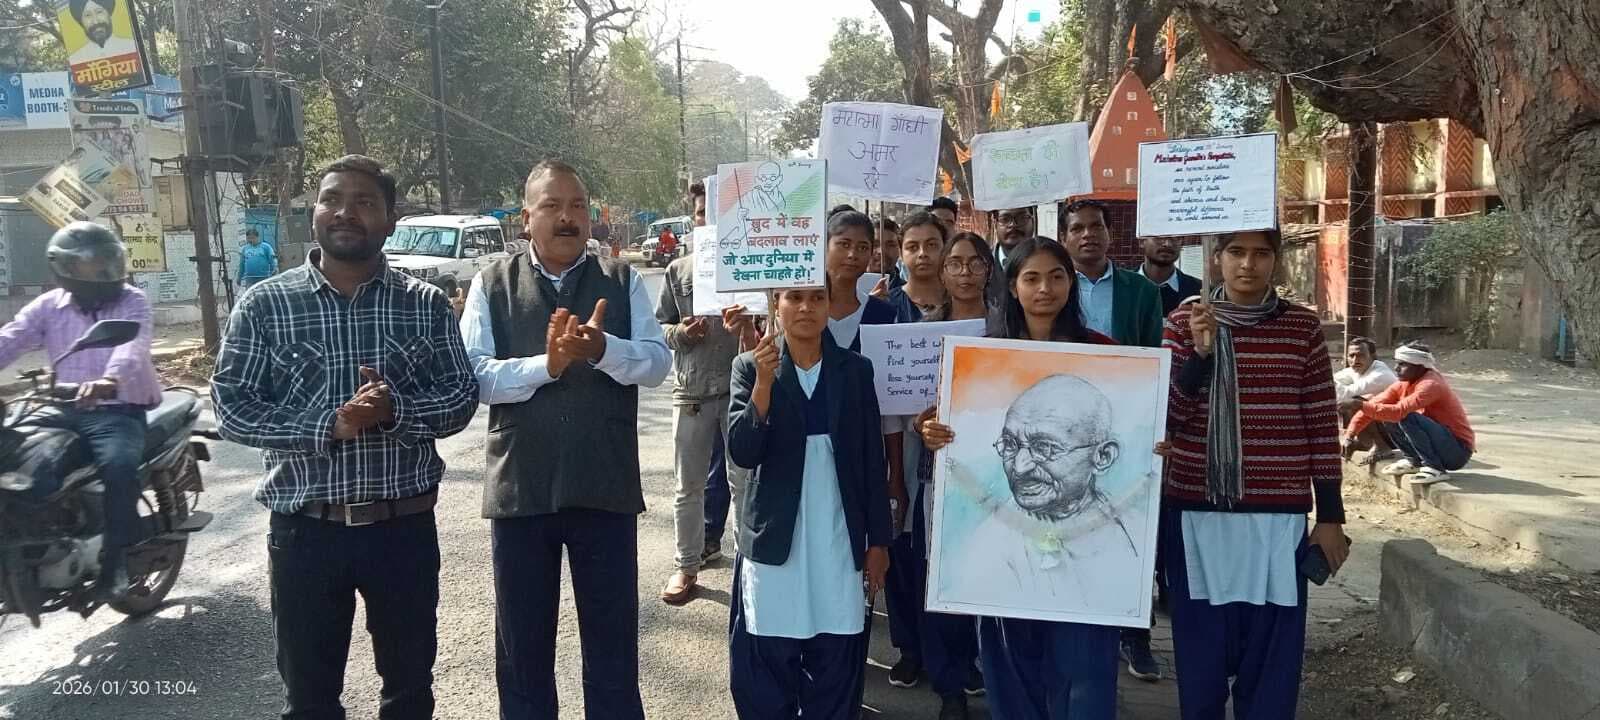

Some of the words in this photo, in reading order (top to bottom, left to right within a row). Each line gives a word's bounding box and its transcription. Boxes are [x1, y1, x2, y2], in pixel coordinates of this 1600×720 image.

[75, 59, 138, 83] मोंगिया
[29, 87, 65, 98] MEDHA
[847, 141, 899, 162] अमर
[863, 166, 888, 190] रहे
[775, 213, 788, 228] में
[791, 216, 813, 230] वह
[747, 235, 790, 248] बदलाव
[722, 252, 738, 266] जो
[740, 253, 765, 266] आप
[765, 248, 799, 268] दुनिया
[802, 250, 816, 262] में
[732, 269, 763, 282] देखना
[763, 266, 794, 280] चाहते
[884, 340, 903, 350] The
[910, 338, 927, 349] best
[911, 354, 940, 367] yourself
[887, 386, 913, 396] Service
